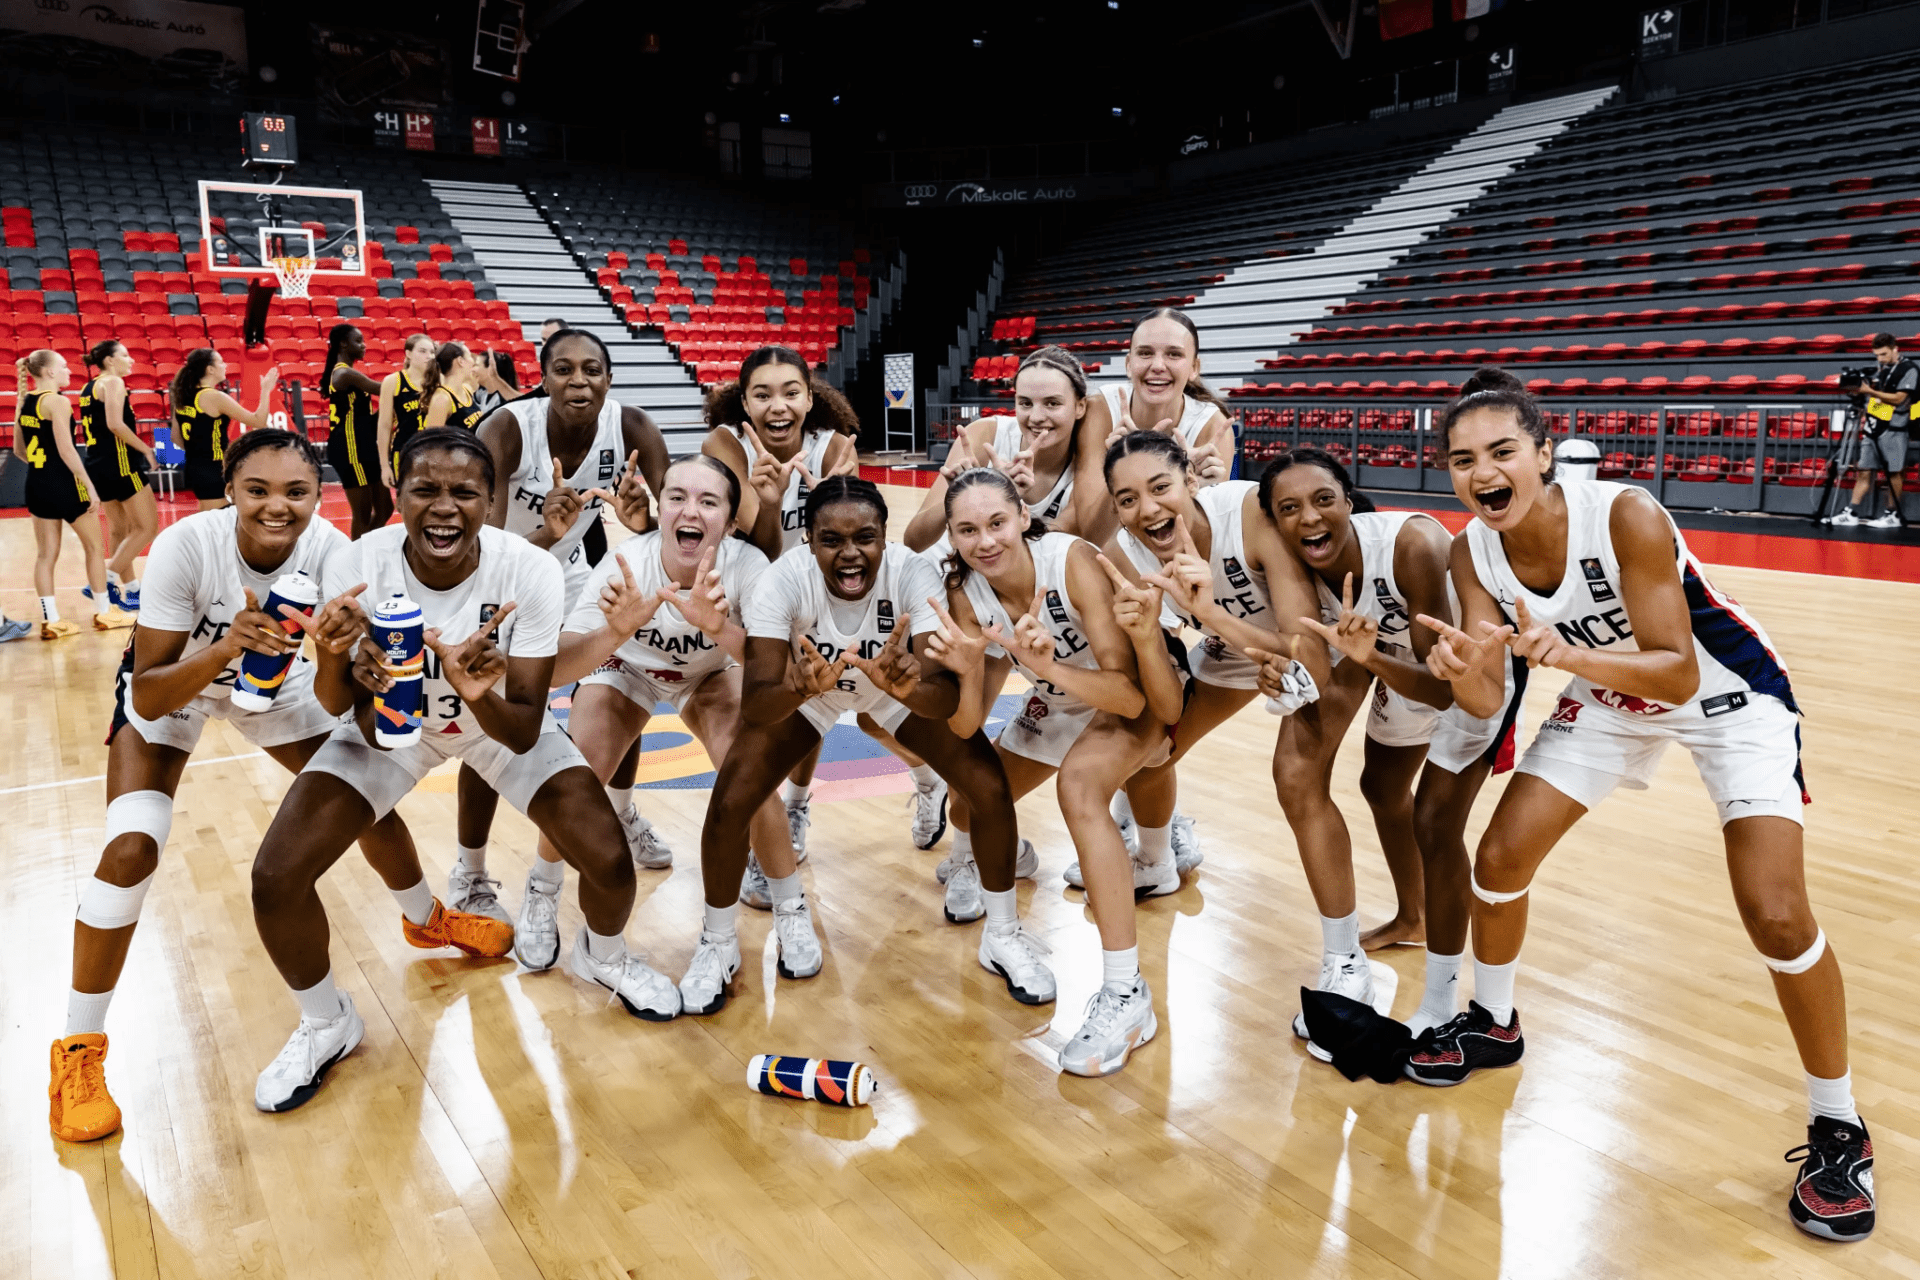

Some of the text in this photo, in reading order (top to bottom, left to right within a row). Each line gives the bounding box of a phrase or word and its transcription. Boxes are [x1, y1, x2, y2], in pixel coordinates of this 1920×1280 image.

[1643, 12, 1660, 37] K
[1501, 48, 1513, 70] J
[385, 112, 399, 130] H
[406, 114, 420, 132] H
[26, 435, 47, 469] 4
[1592, 583, 1608, 592] FIBA
[836, 679, 857, 692] 6
[1732, 696, 1742, 705] M
